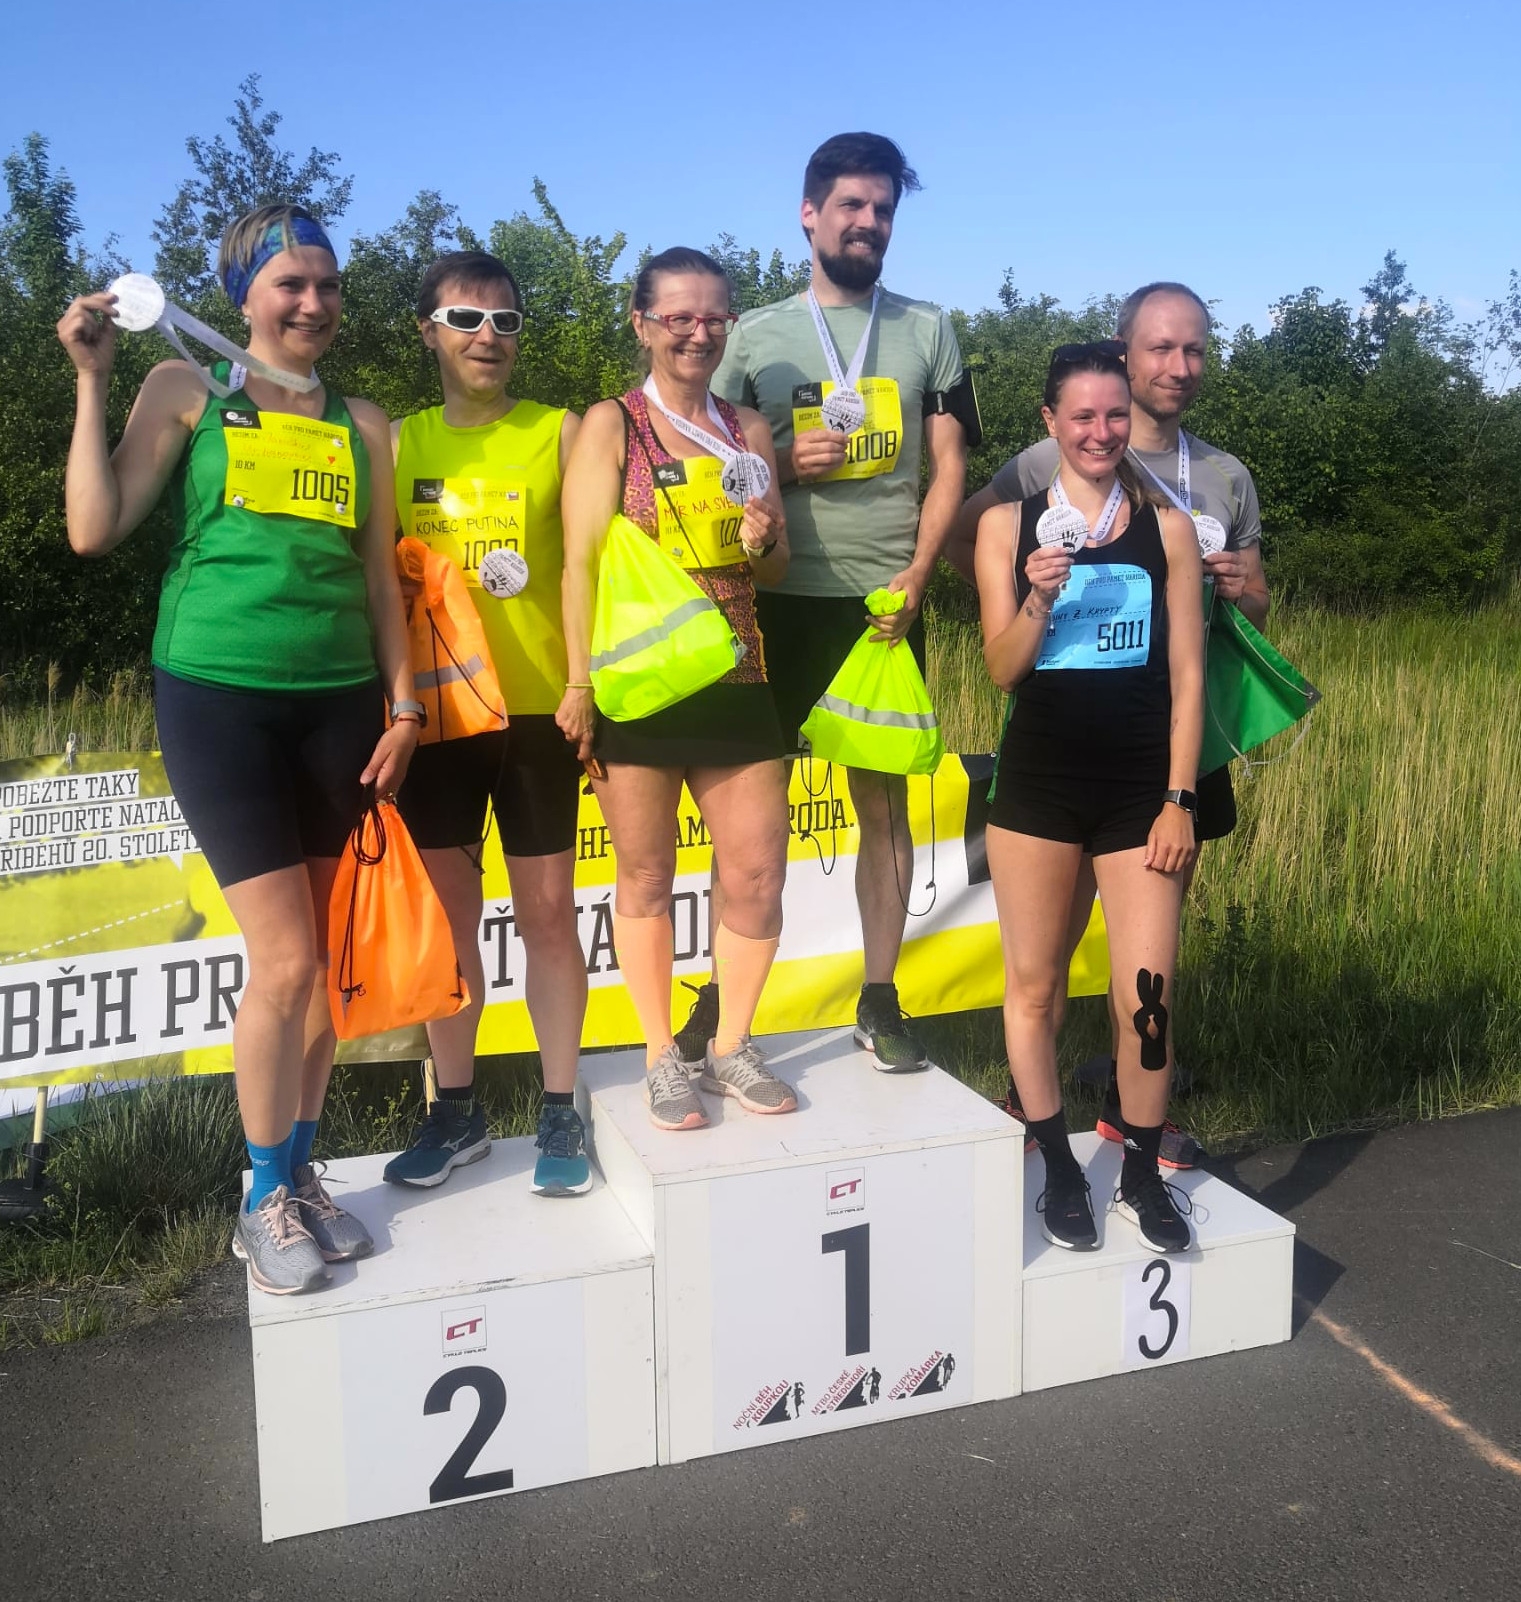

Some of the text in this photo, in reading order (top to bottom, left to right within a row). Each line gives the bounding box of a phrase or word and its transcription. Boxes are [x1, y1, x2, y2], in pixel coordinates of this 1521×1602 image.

[847, 430, 897, 464] 1008
[244, 460, 256, 471] KM
[291, 468, 350, 506] 1005
[692, 499, 712, 514] NA
[415, 515, 519, 535] KONEC PUTINA
[1097, 619, 1144, 652] 5011
[0, 773, 138, 808] OBĚŽTE TAKY
[83, 838, 112, 861] 20.
[121, 828, 199, 857] STOLET
[0, 965, 138, 1062] BĚH
[821, 1222, 870, 1356] 1
[1138, 1259, 1179, 1359] 3
[887, 1367, 918, 1400] KRUPKA
[904, 1350, 943, 1393] KOMÁRKA
[732, 1385, 773, 1431] NOČNÍ BĚH
[751, 1380, 789, 1423] KRUPKOU
[423, 1365, 514, 1504] 2
